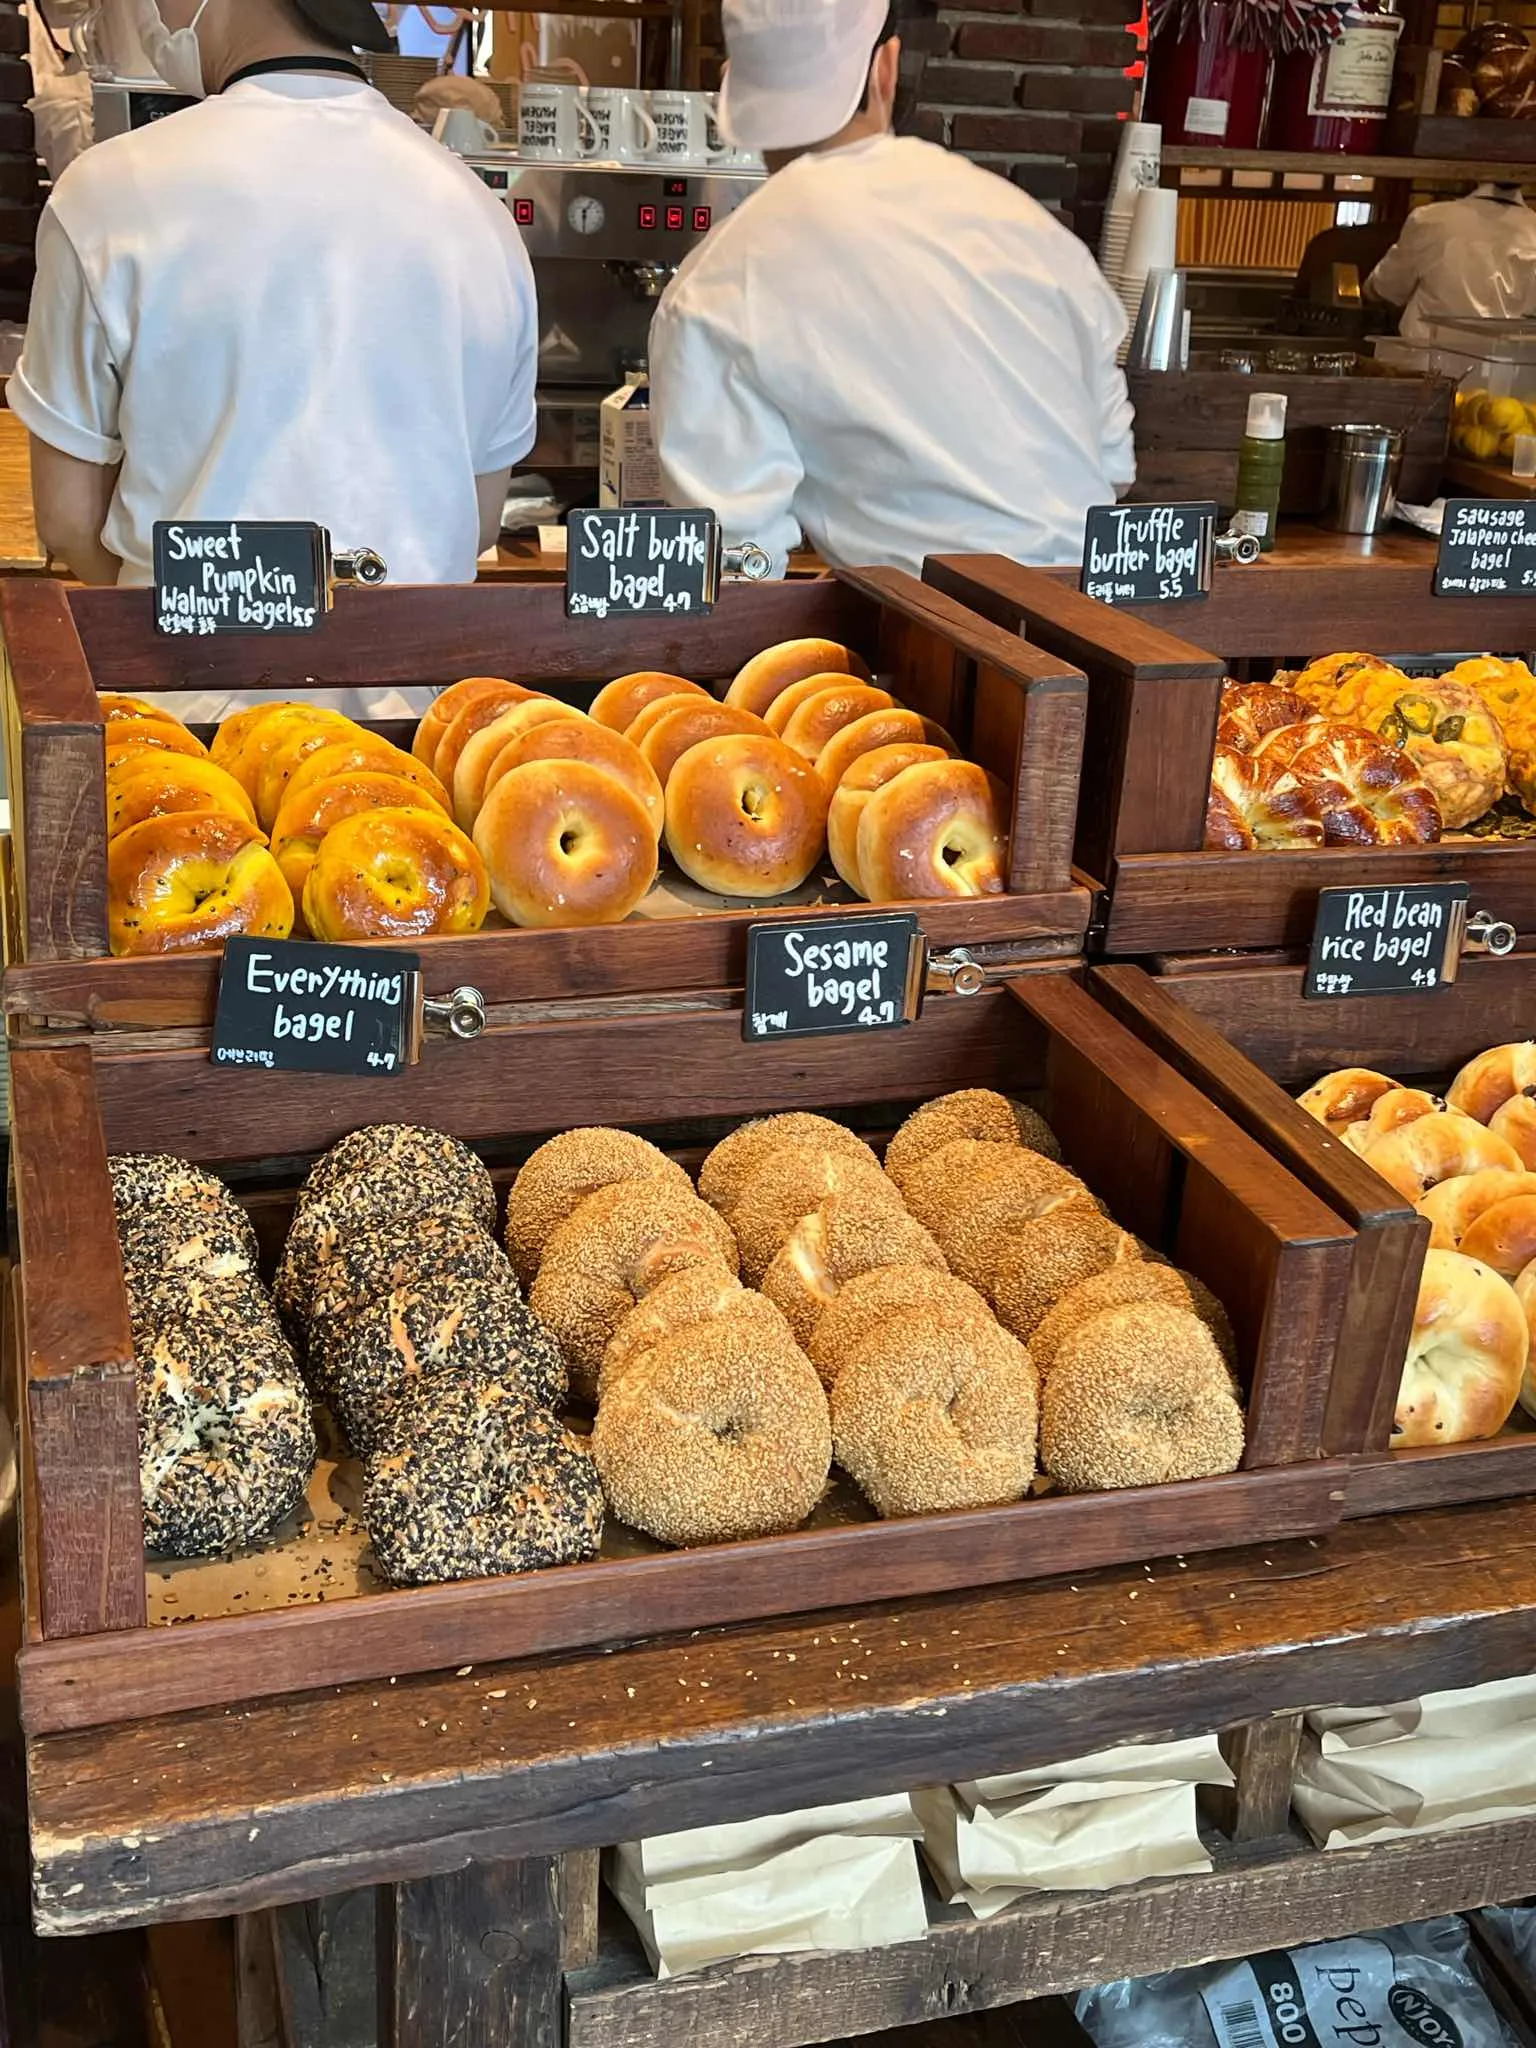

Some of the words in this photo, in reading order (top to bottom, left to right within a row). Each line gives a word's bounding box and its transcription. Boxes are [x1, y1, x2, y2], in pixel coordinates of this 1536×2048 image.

[524, 120, 557, 134] BAGEL
[168, 523, 242, 560] Sweet
[581, 513, 640, 562] Salt
[648, 516, 705, 566] butte
[1109, 508, 1184, 550] Truffle
[202, 555, 297, 602] Pumpkin
[1090, 537, 1150, 575] butter
[1155, 538, 1198, 579] bagel
[1471, 547, 1512, 571] bagel
[161, 585, 231, 616] Walnut
[569, 592, 610, 619] 소금빵
[609, 563, 665, 609] bagel
[1159, 578, 1183, 600] 5.5
[1344, 890, 1389, 932] Red
[1392, 890, 1442, 930] bean
[784, 932, 888, 977] Sesame
[1321, 935, 1366, 961] rice
[1373, 931, 1433, 966] bagel
[247, 953, 402, 1005] Everything
[807, 968, 880, 1015] bagel
[1410, 968, 1437, 987] 4.8
[273, 1004, 355, 1042] bagel
[858, 1001, 894, 1025] 4.7
[1269, 1981, 1307, 2044] 800
[1314, 1964, 1386, 2048] pep
